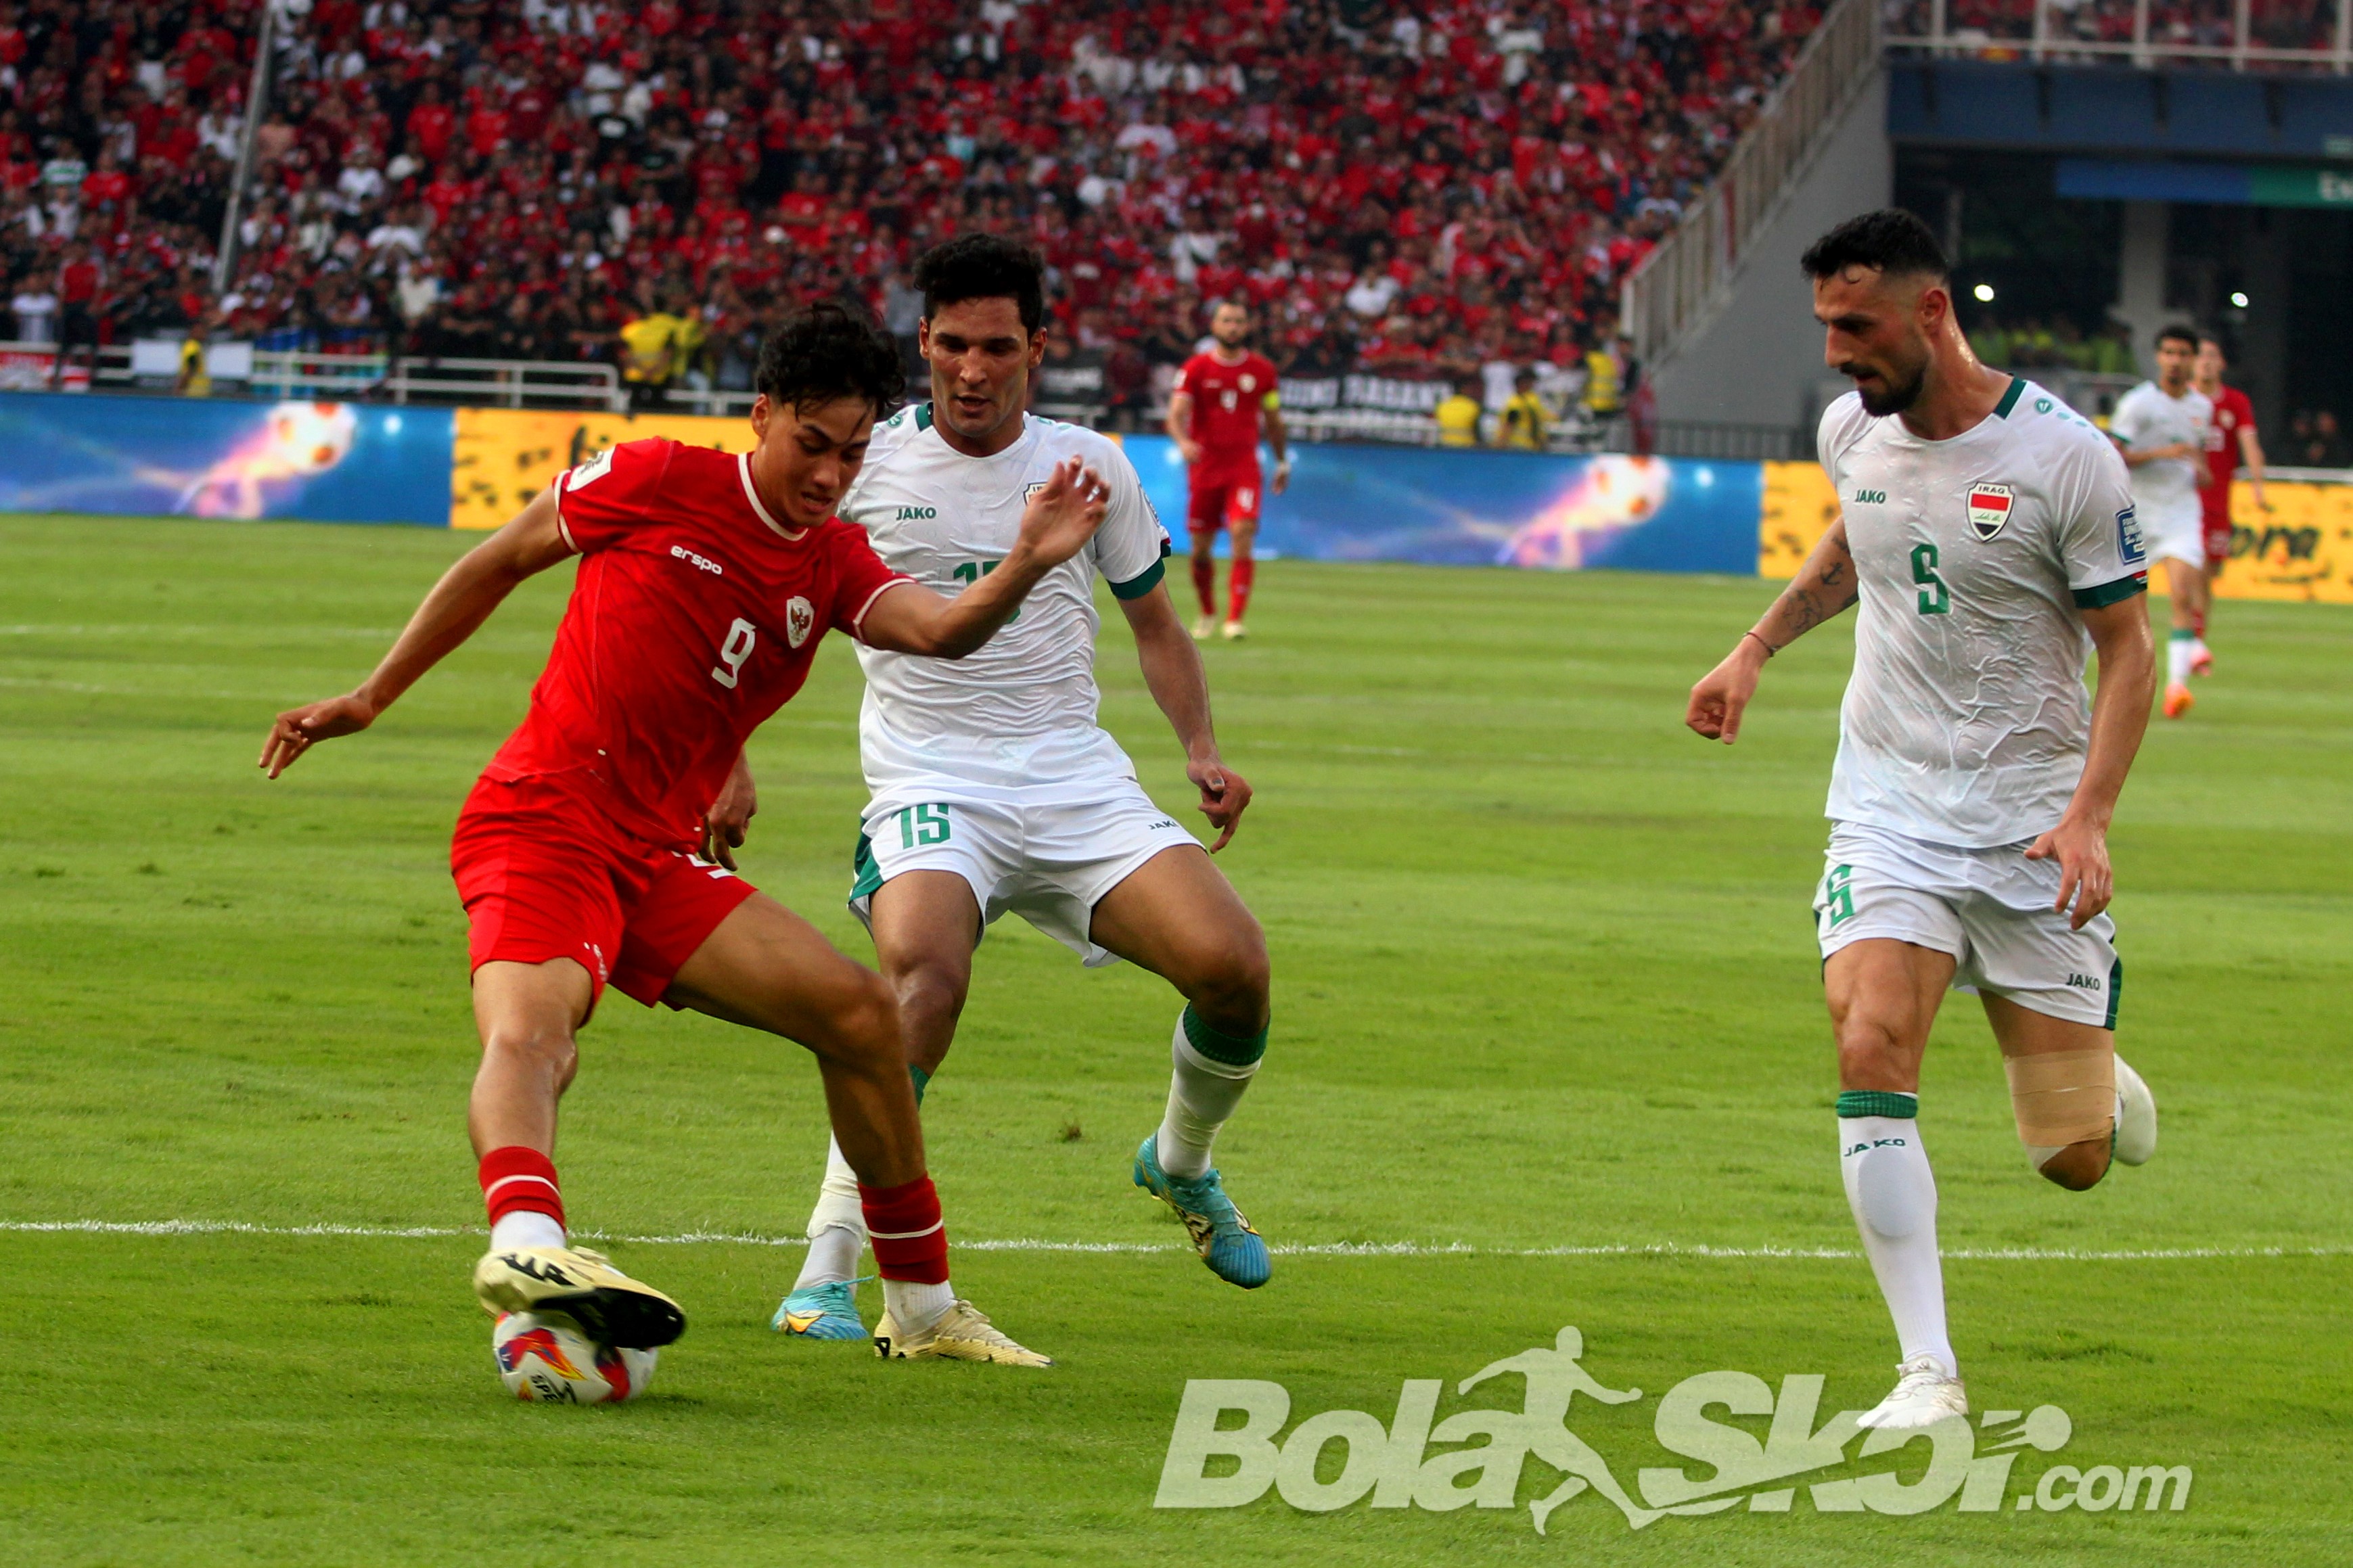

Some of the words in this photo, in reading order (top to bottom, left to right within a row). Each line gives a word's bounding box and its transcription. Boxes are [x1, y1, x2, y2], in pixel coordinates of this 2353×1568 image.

[1855, 489, 1886, 504] JAKO
[1978, 486, 2005, 494] IRAQ
[896, 507, 936, 521] JAKO
[670, 545, 723, 575] erspo
[711, 617, 756, 689] 9
[890, 803, 951, 850] 15
[2065, 973, 2101, 991] JAKO
[1844, 1138, 1906, 1157] JAKO
